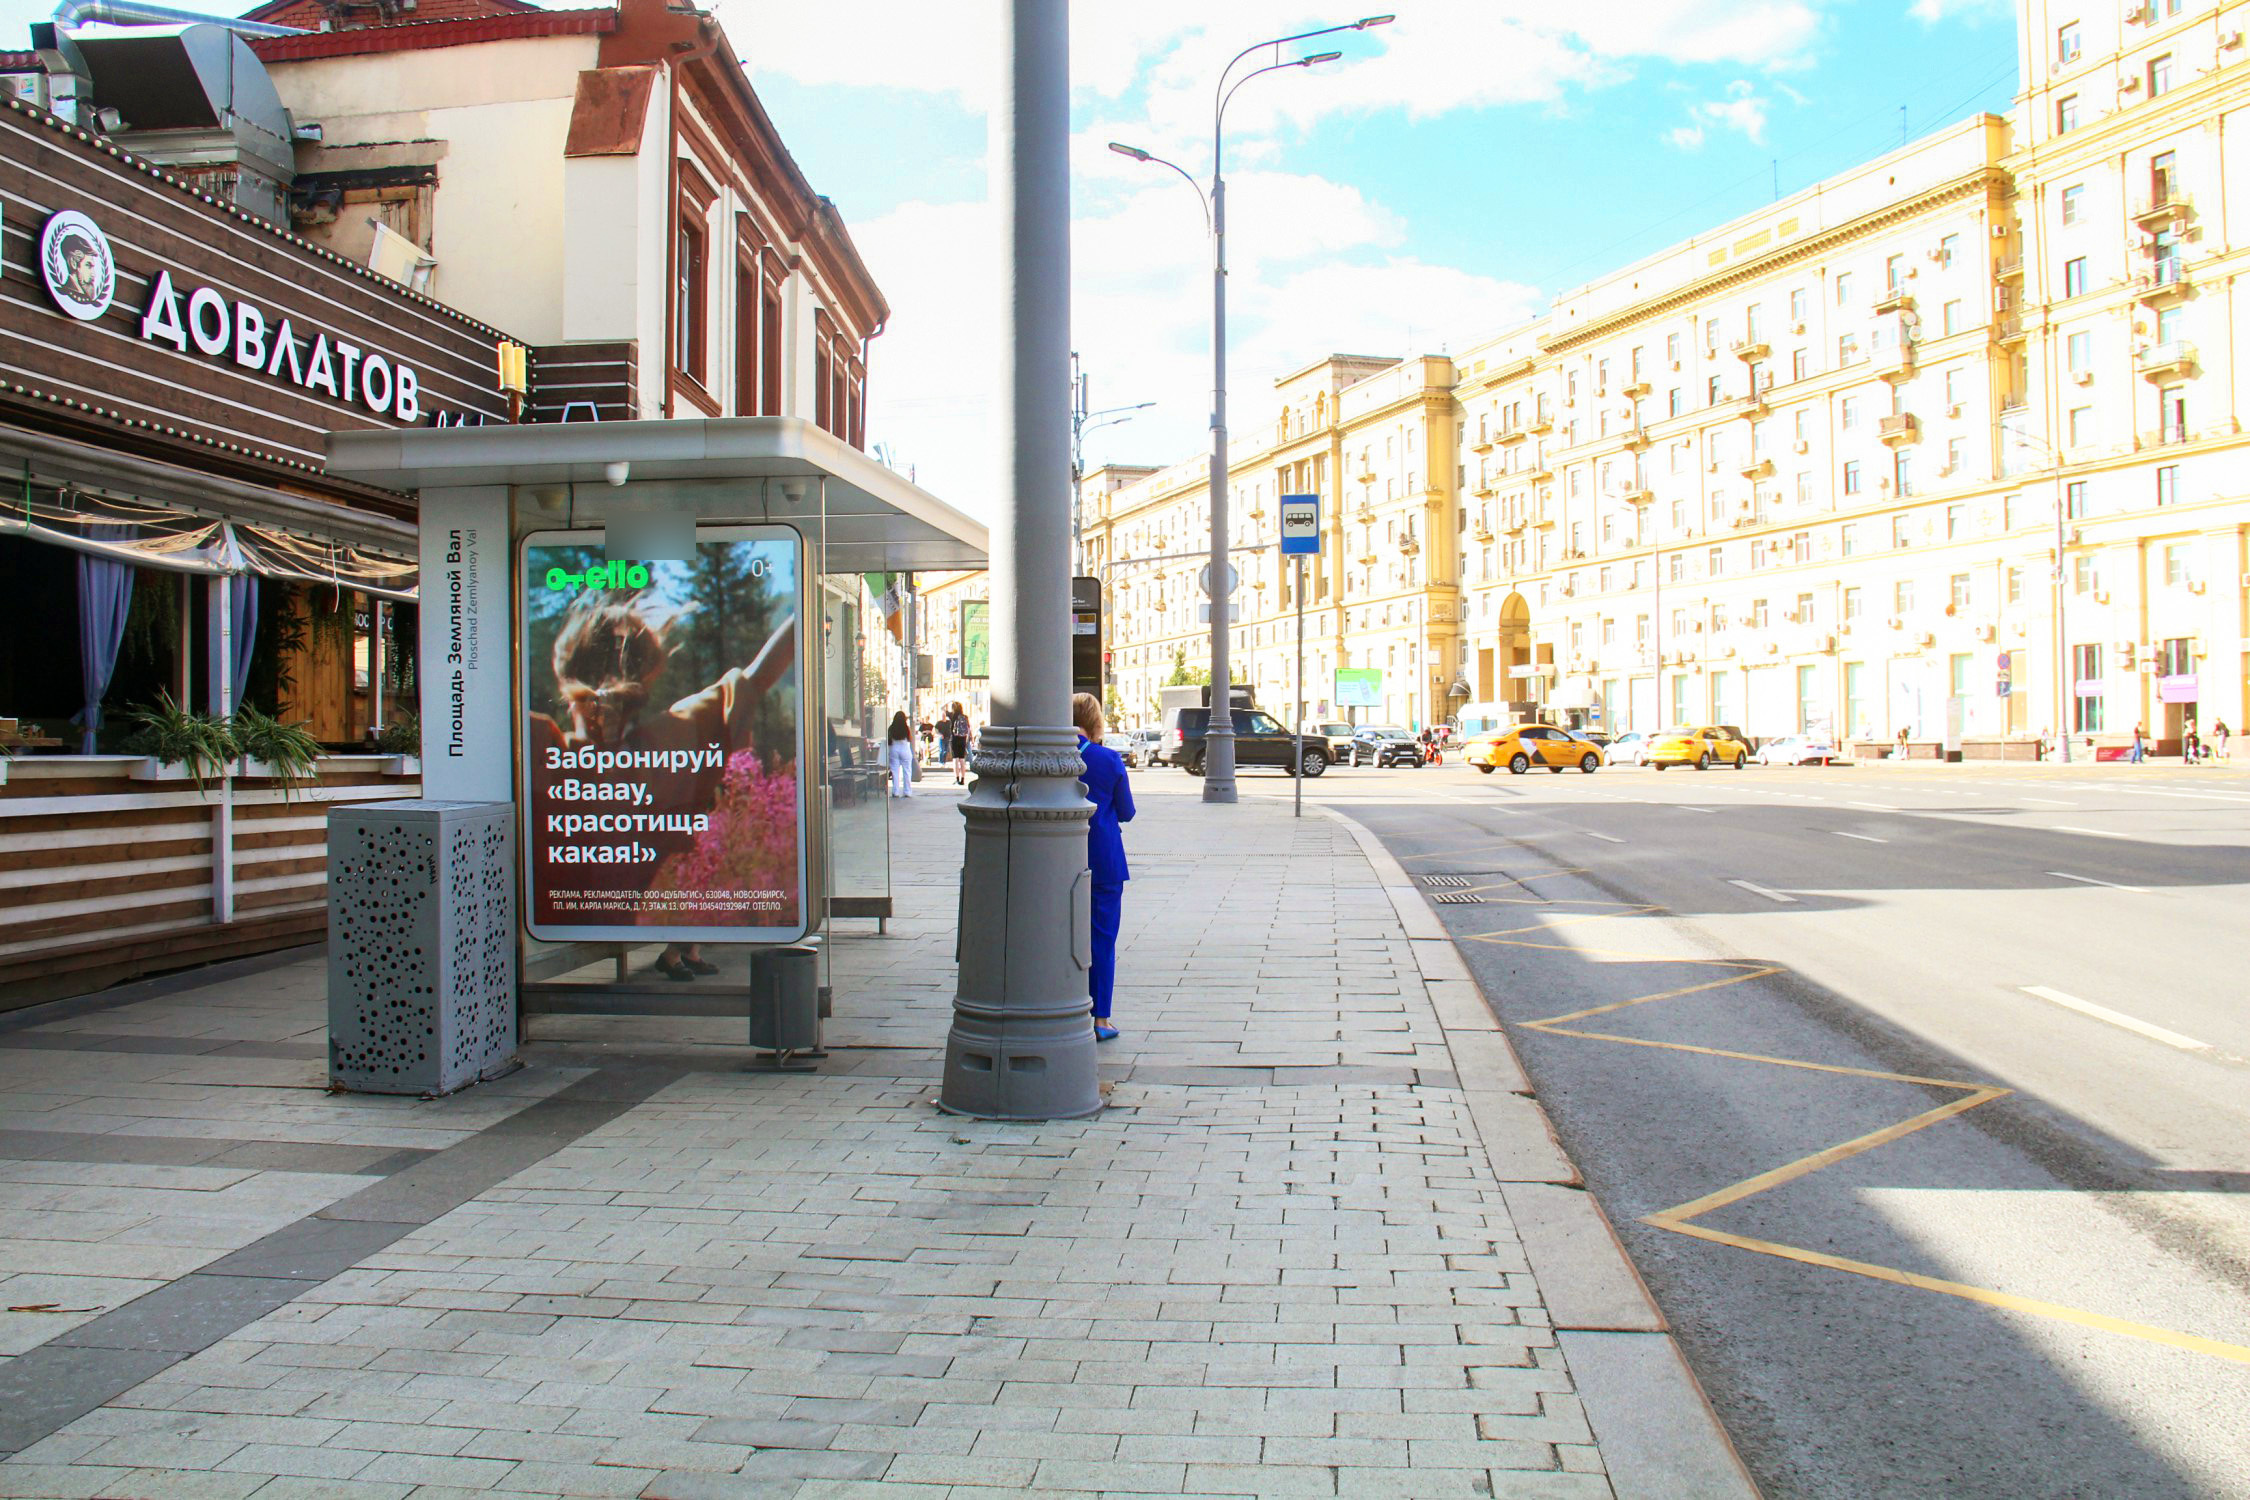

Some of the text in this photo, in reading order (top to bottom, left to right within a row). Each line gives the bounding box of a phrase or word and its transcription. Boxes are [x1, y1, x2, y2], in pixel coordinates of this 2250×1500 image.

[143, 270, 418, 422] ДОВЛАТОВ
[752, 560, 775, 577] 0+
[466, 529, 480, 670] Ploschad Zemlyanoy Val
[447, 529, 464, 756] Площадь Земляной Вал
[546, 743, 723, 773] Забронируй
[547, 779, 653, 806] «Вааау,
[548, 813, 709, 837] красотища
[549, 842, 657, 863] какая!»
[549, 890, 582, 899] РЕКЛАМА.
[583, 890, 642, 900] РЕКЛАМОДАТЕЛЬ:
[644, 890, 660, 899] ООО
[705, 890, 732, 900] 630048,
[733, 890, 787, 900] НОВОСИБИРСК,
[553, 902, 565, 910] ПЛ.
[566, 902, 578, 910] ИМ.
[580, 902, 602, 910] КАРЛА
[603, 902, 632, 912] МАРКСА,
[649, 902, 668, 910] ЭТАЖ
[680, 902, 698, 910] ОГРН
[752, 902, 783, 911] ОТЕЛЛО.
